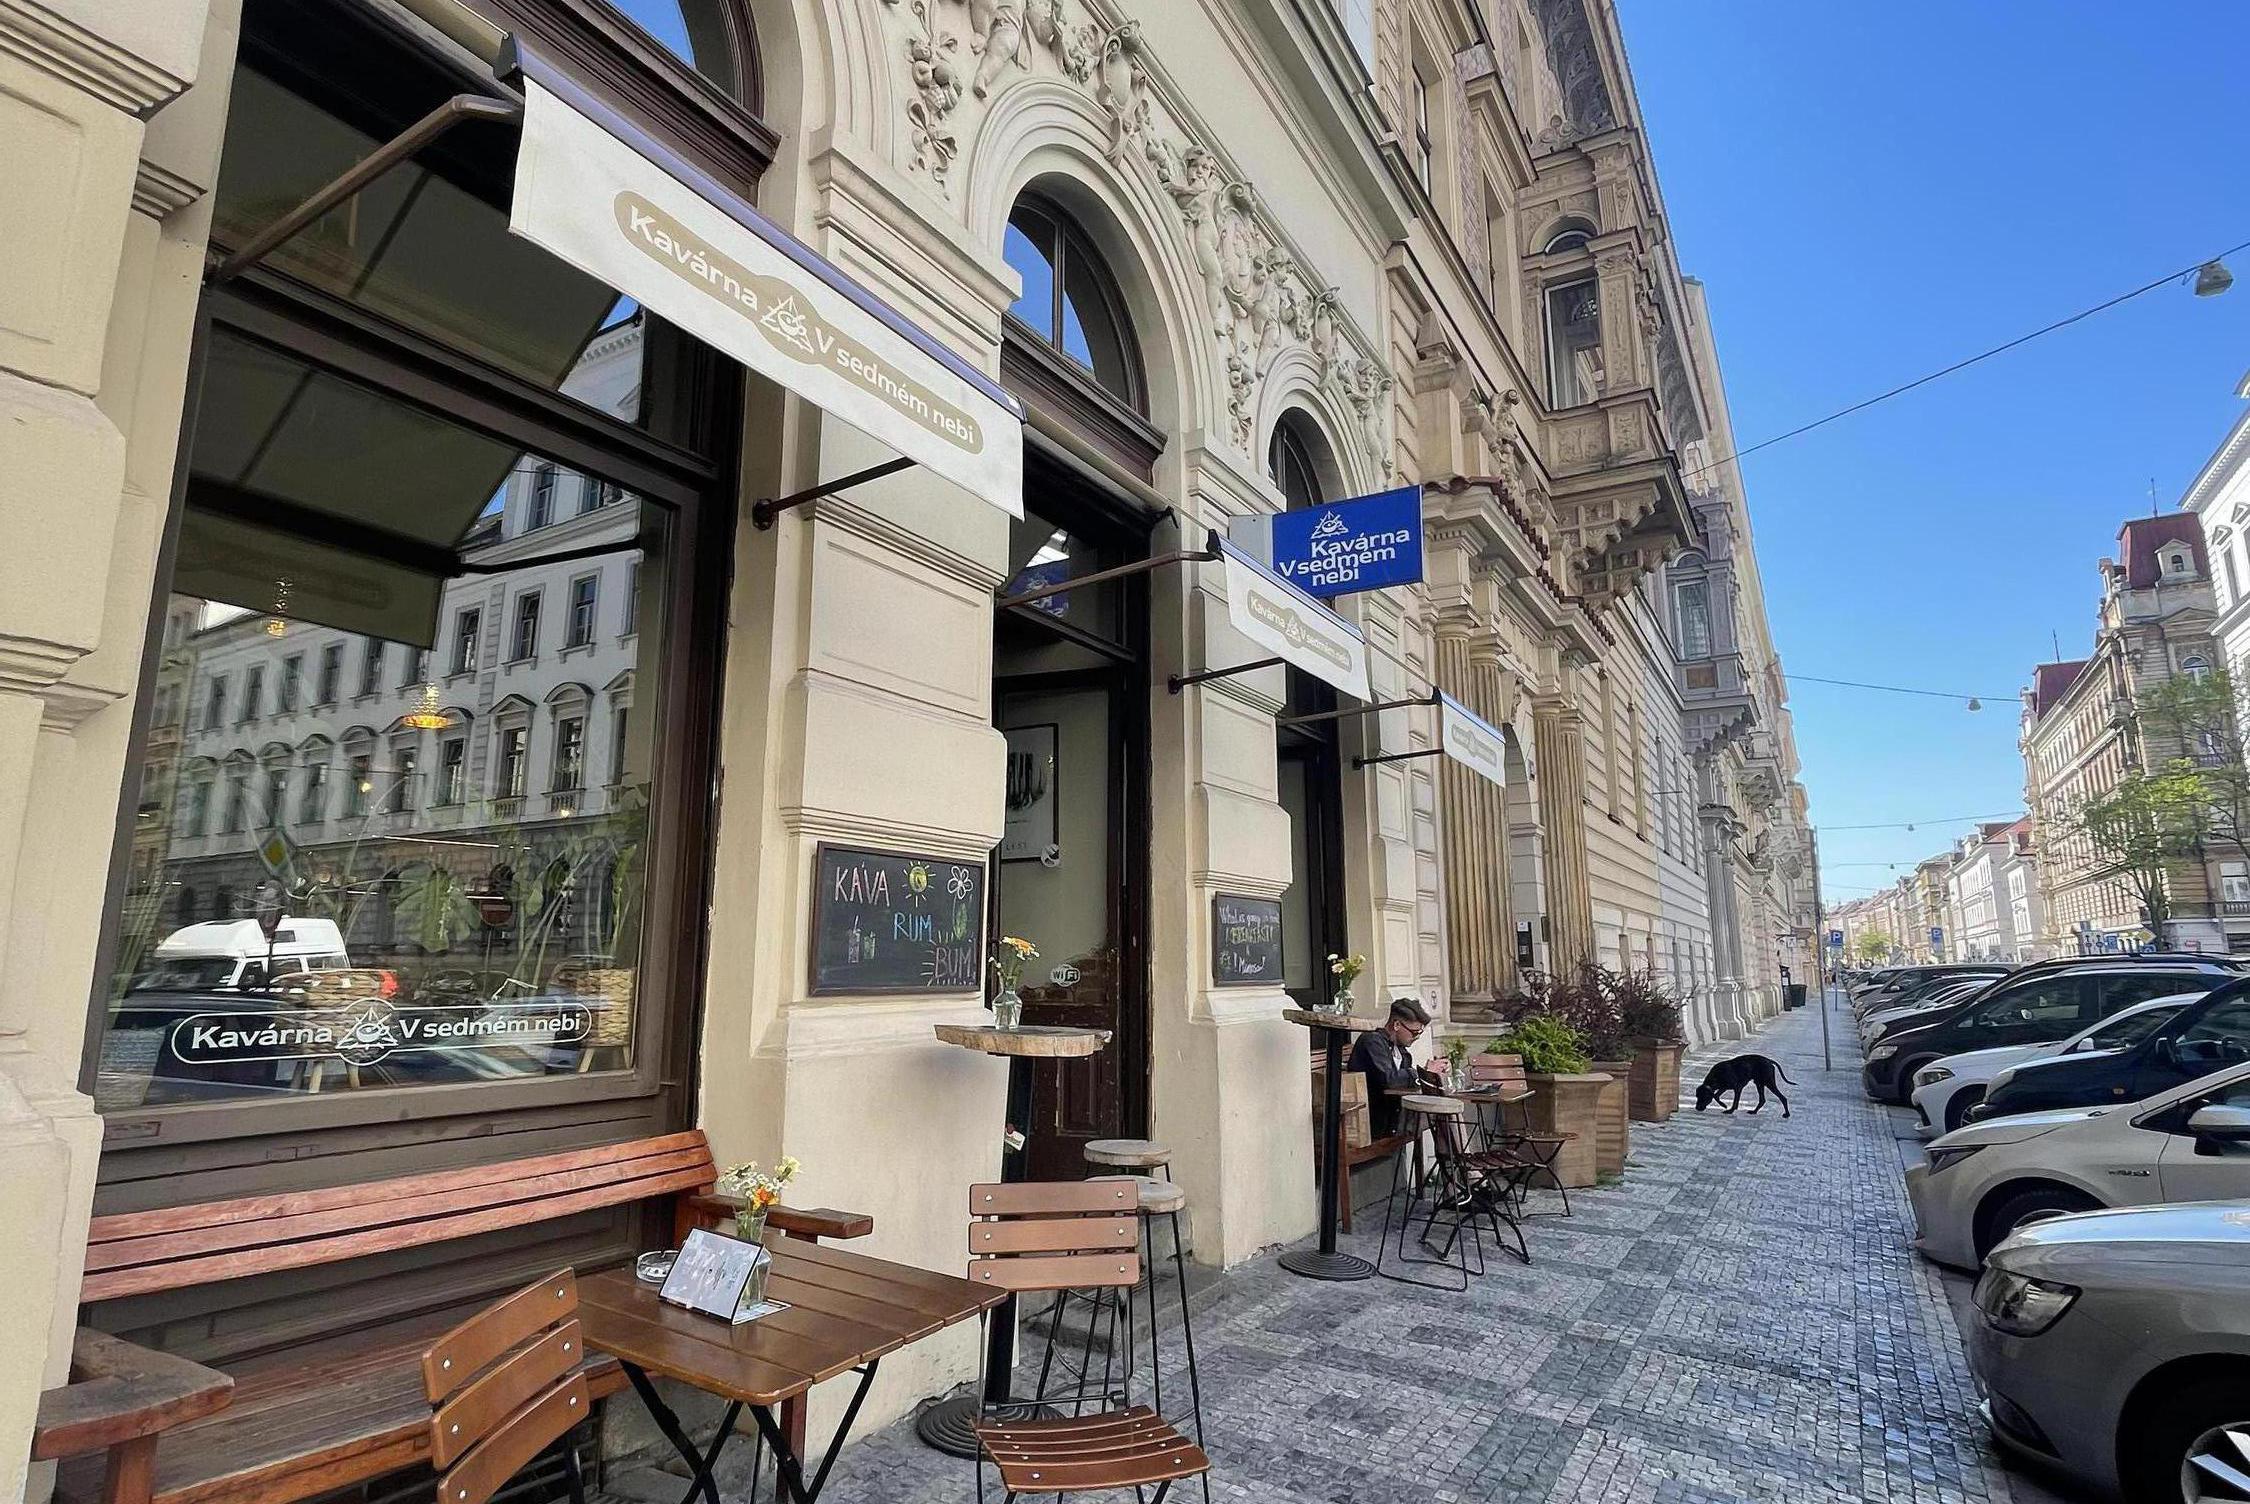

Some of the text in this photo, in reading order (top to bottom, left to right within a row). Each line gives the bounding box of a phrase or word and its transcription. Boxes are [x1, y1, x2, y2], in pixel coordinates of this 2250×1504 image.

[630, 205, 974, 444] Kavárna V sedmém nebi
[1310, 529, 1410, 559] Kavárna
[1280, 547, 1396, 577] V sedmém
[1312, 567, 1360, 587] nebi
[1250, 597, 1286, 628] Kavárna
[893, 912, 932, 941] RUM
[935, 938, 977, 980] BUM!
[192, 1013, 581, 1050] Kavárna V sedmém nebi
